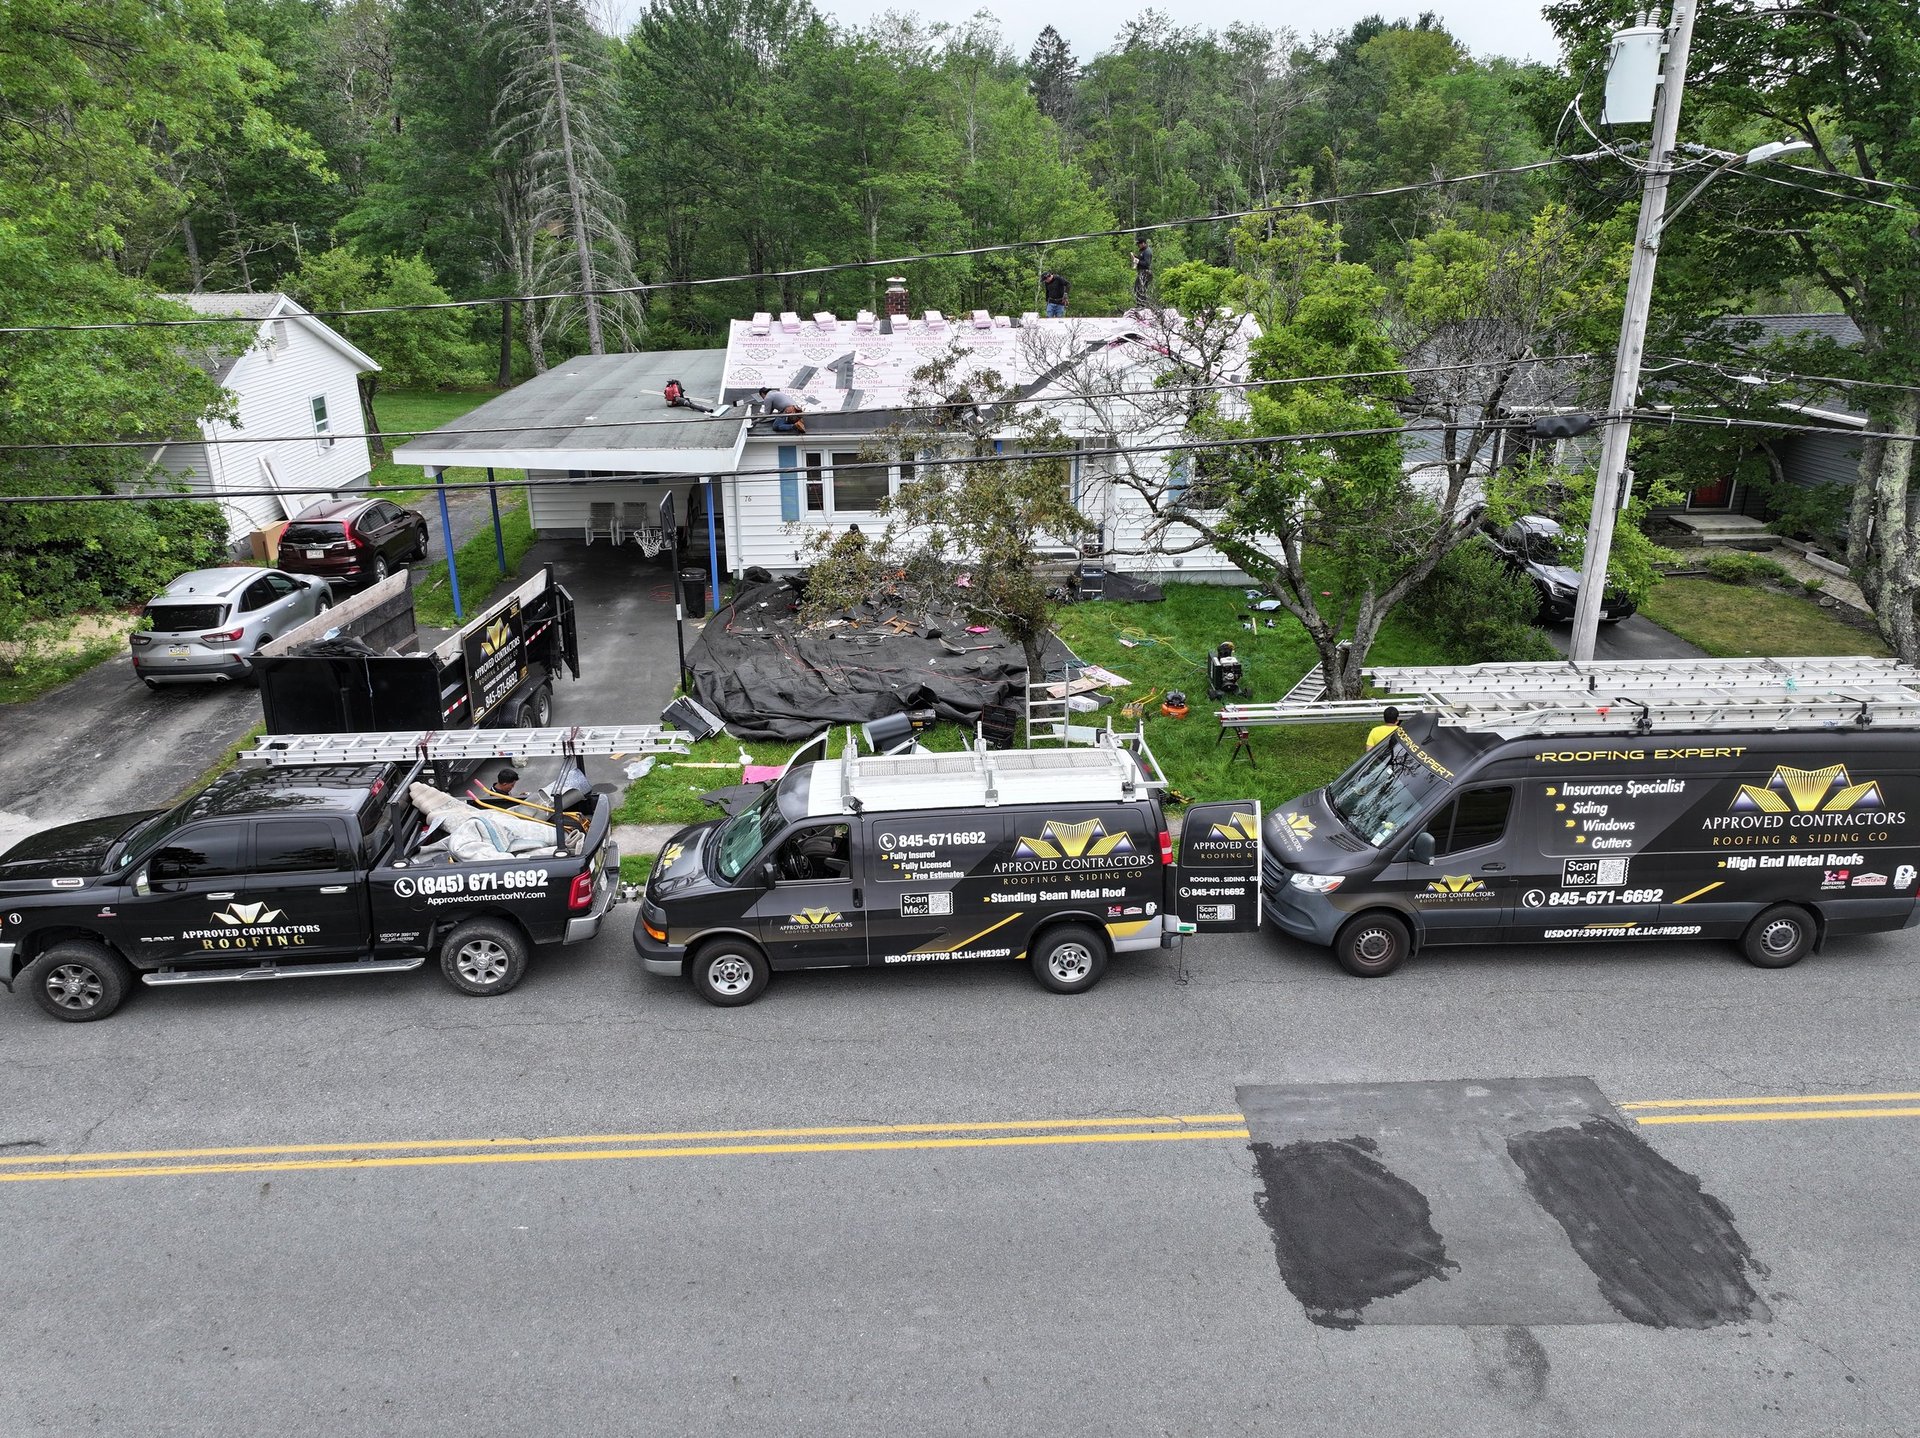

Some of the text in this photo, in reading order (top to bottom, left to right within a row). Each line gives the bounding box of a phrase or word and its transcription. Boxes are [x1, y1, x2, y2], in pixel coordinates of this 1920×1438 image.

[1542, 747, 1747, 762] ROOFING EXPERT
[1417, 751, 1454, 779] EXPERT
[1562, 780, 1685, 798] Insurance Specialist
[1572, 802, 1608, 816] Siding
[1583, 818, 1635, 831] Windows
[1702, 812, 1906, 830] APPROVED CONTRACTORS
[899, 832, 986, 847] 845-6716692
[1193, 841, 1242, 850] APPROVED
[1592, 837, 1632, 849] Gutters
[1713, 832, 1888, 845] ROOFING & SIDING CO
[890, 851, 935, 861] Fully Insured
[1727, 853, 1864, 870] High End Metal Roofs
[901, 860, 951, 871] Fully Licensed
[993, 854, 1154, 873] APPROVED CONTRACTORS
[1568, 861, 1597, 871] Scan
[930, 870, 964, 879] Estimates
[1003, 873, 1057, 885] ROOFING
[1080, 872, 1120, 881] SIDING
[1127, 870, 1142, 878] CO
[1566, 874, 1585, 885] Me
[418, 869, 548, 895] (845) 671-6692
[427, 891, 546, 905] ApprovedcontractorNY.com
[904, 895, 927, 903] Scan
[991, 887, 1126, 904] Standing Seam Metal Roof
[1549, 889, 1663, 906] 845-671-6692
[904, 905, 918, 914] Me
[183, 925, 320, 939] APPROVED CONTRACTORS
[1544, 926, 1701, 939] USDOT#3991702 RC.Lic#H23259
[202, 935, 305, 950] ROOFING
[885, 948, 1010, 963] USDOT#3991702 RC.Lic#H23259
